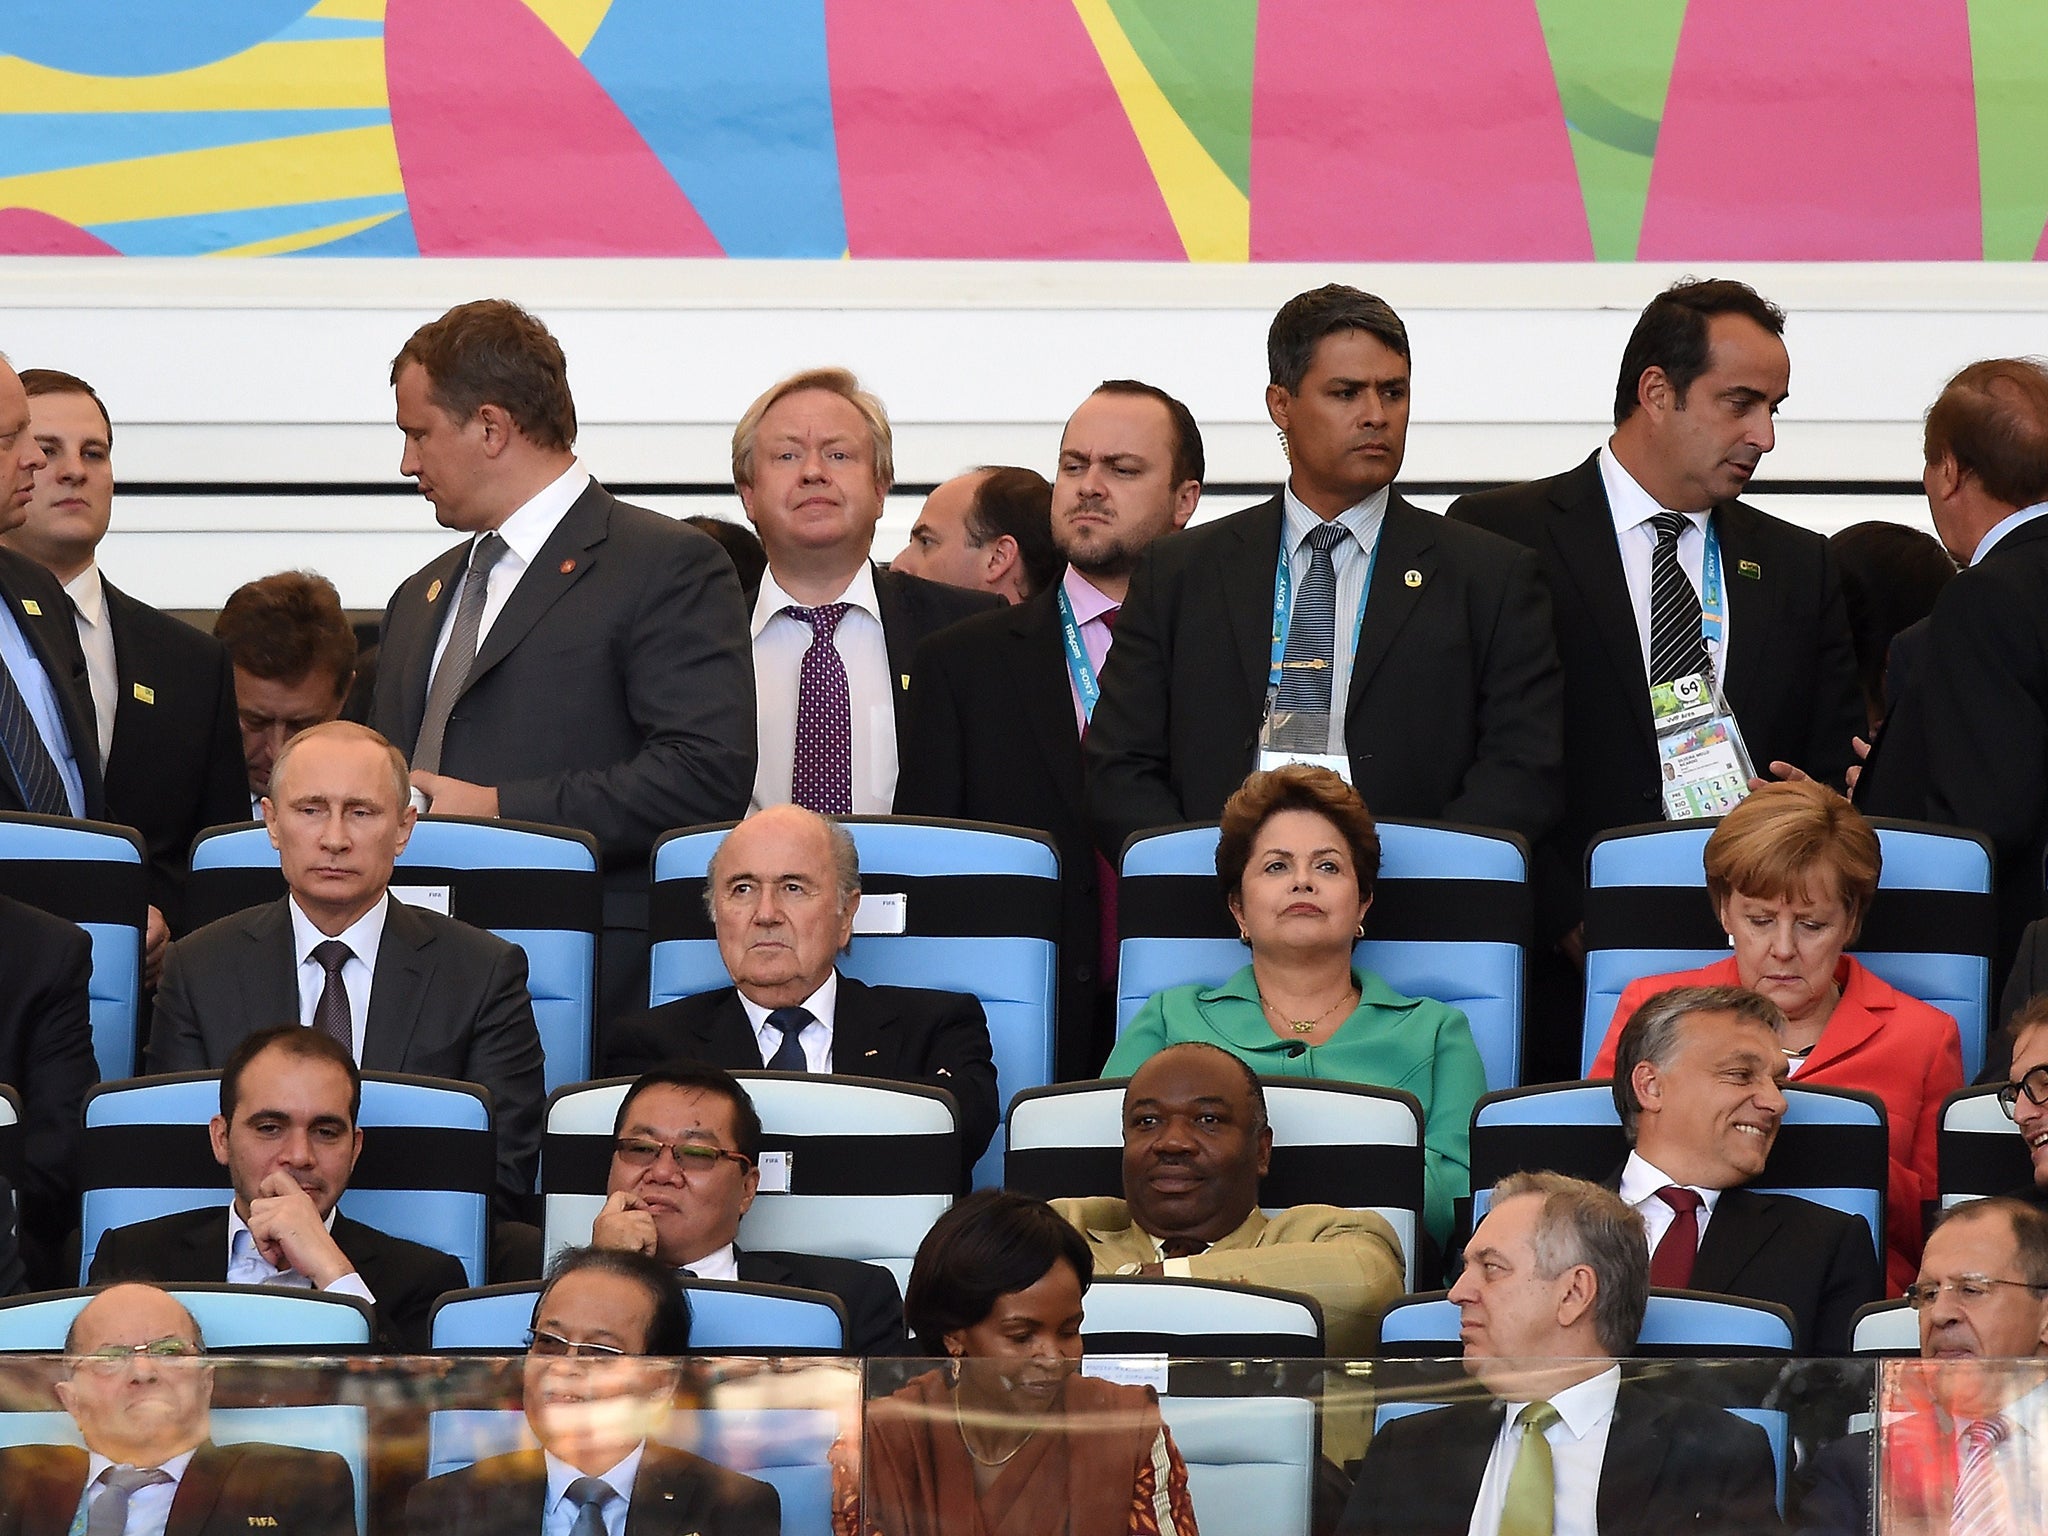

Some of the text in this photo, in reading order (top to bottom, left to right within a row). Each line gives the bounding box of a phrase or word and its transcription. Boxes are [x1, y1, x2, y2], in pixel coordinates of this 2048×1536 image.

[1277, 577, 1287, 610] SONY
[1065, 624, 1081, 658] FIFA.com
[1080, 668, 1095, 695] SONY
[1680, 680, 1698, 695] 64
[1697, 786, 1703, 796] 1
[1713, 781, 1722, 790] 2
[1729, 776, 1738, 785] 3
[1704, 802, 1712, 811] 4
[1720, 797, 1728, 806] 5
[247, 1516, 278, 1527] FIFA
